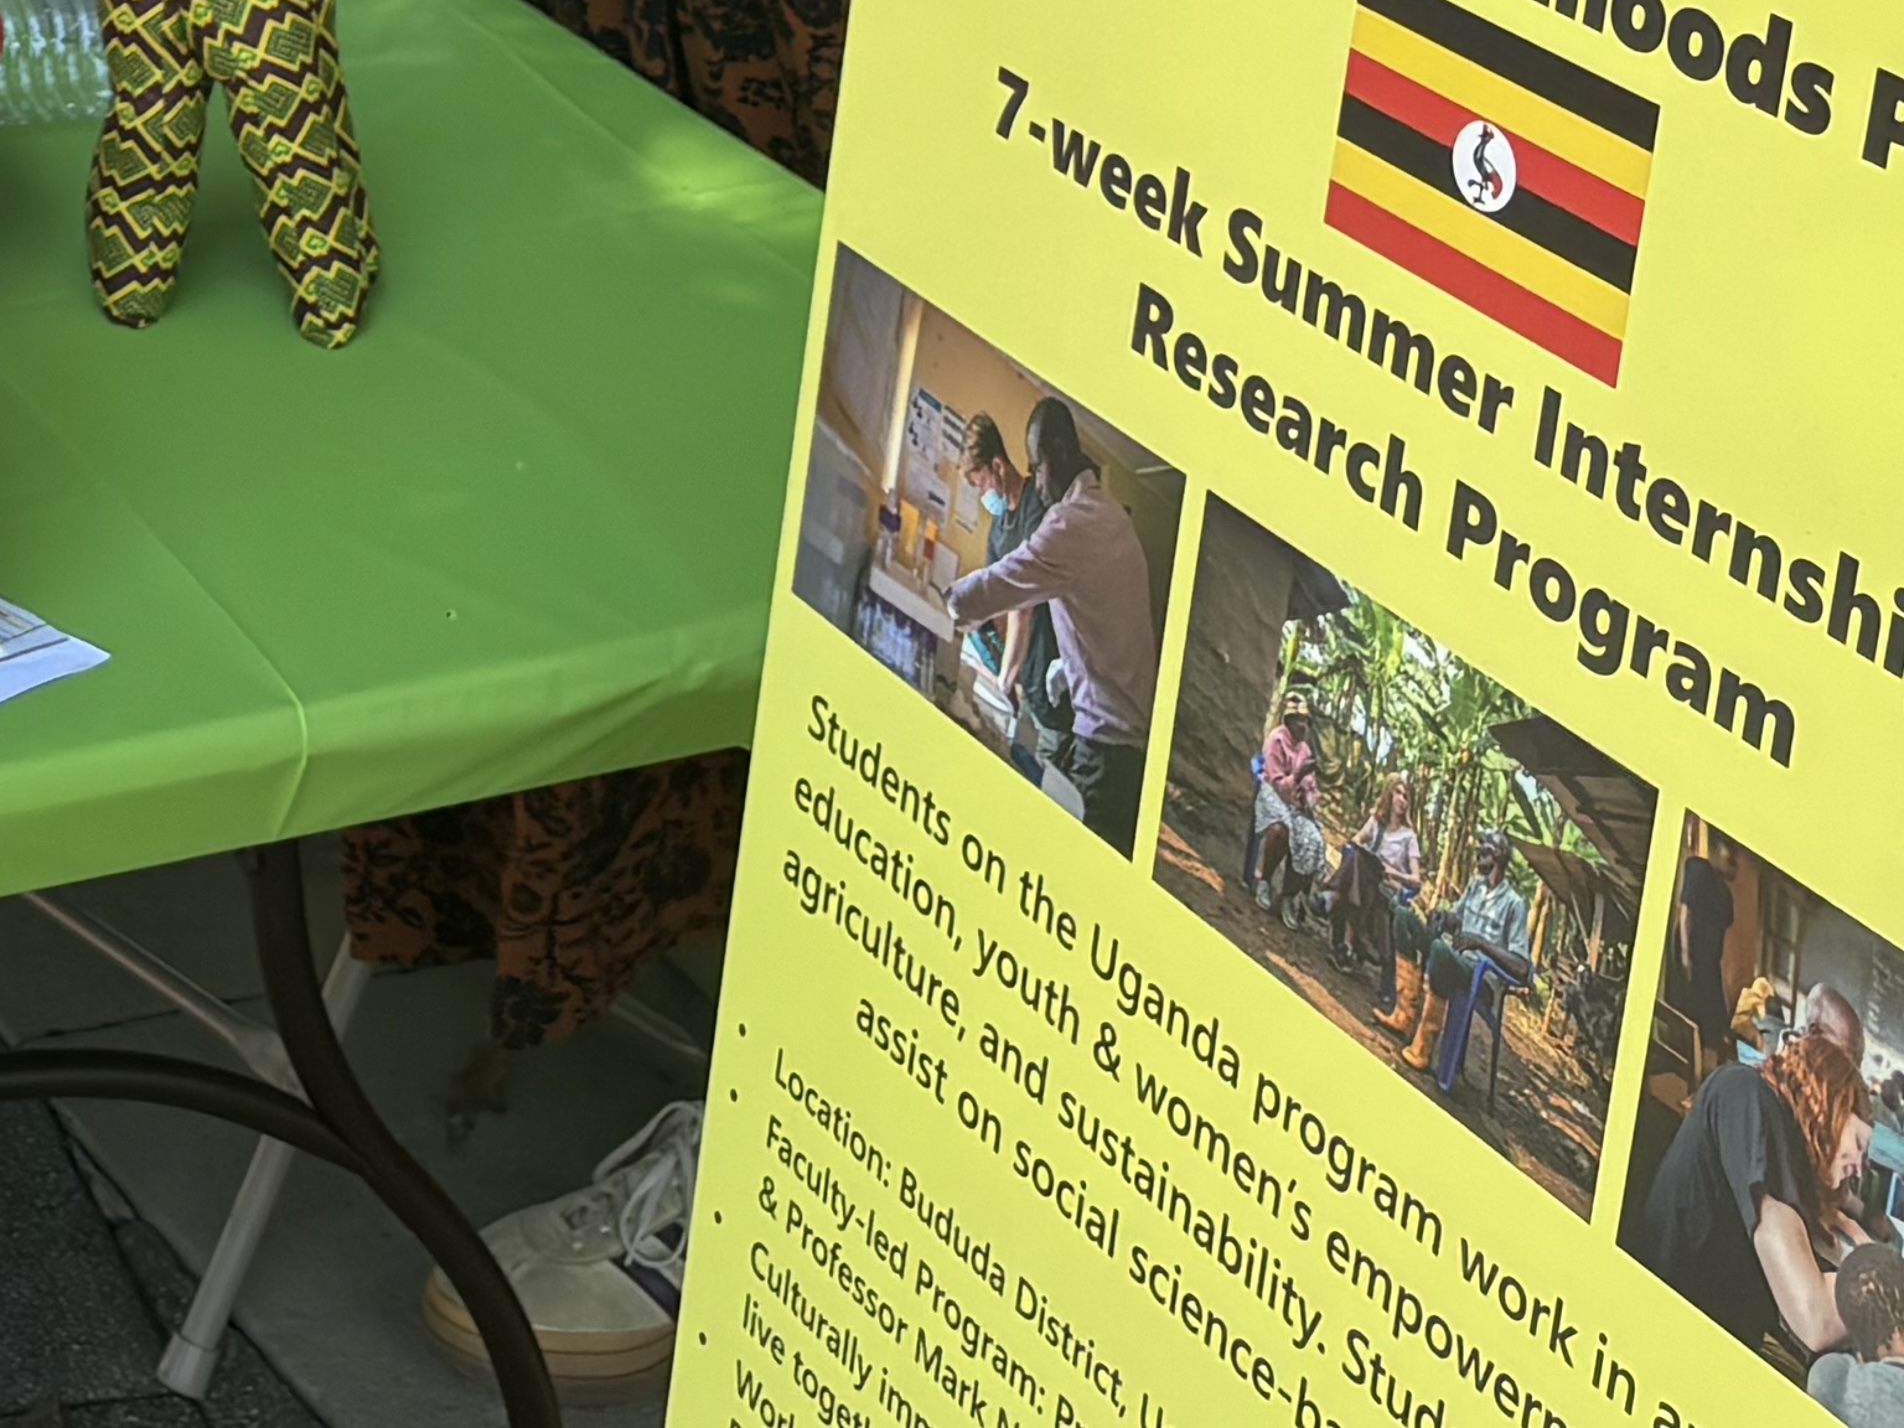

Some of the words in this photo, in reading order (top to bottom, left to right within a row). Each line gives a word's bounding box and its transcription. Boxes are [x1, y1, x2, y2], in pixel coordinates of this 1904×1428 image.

[996, 67, 1207, 257] 7-week
[1223, 208, 1514, 433] Summer
[1132, 283, 1422, 531] Research
[1447, 480, 1794, 768] Program
[784, 850, 965, 1041] agriculture,
[980, 1023, 1048, 1104] and
[1059, 1092, 1324, 1354] sustainability.
[795, 778, 961, 951] education,
[973, 929, 1079, 1044] youth
[1094, 1022, 1120, 1082] &
[1137, 1063, 1311, 1240] women's
[808, 696, 950, 845] Students
[963, 835, 1005, 893] on
[1020, 872, 1076, 950] the
[1092, 924, 1239, 1088] Uganda
[1253, 1073, 1441, 1256] program
[1461, 1238, 1577, 1367] work
[1593, 1333, 1635, 1415] in
[743, 1294, 784, 1365] live
[751, 1242, 888, 1391] Culturally
[759, 1176, 777, 1219] &
[786, 1200, 908, 1343] Professor
[915, 1328, 986, 1428] Mark
[767, 1116, 908, 1279] Faculty-led
[916, 1260, 1045, 1414] Program:
[776, 1049, 891, 1187] Location:
[900, 1167, 1004, 1296] Bududa
[1016, 1277, 1125, 1417] District,
[857, 999, 947, 1104] assist
[958, 1092, 1001, 1153] on
[1014, 1141, 1118, 1257] social
[1130, 1246, 1340, 1428] science-b
